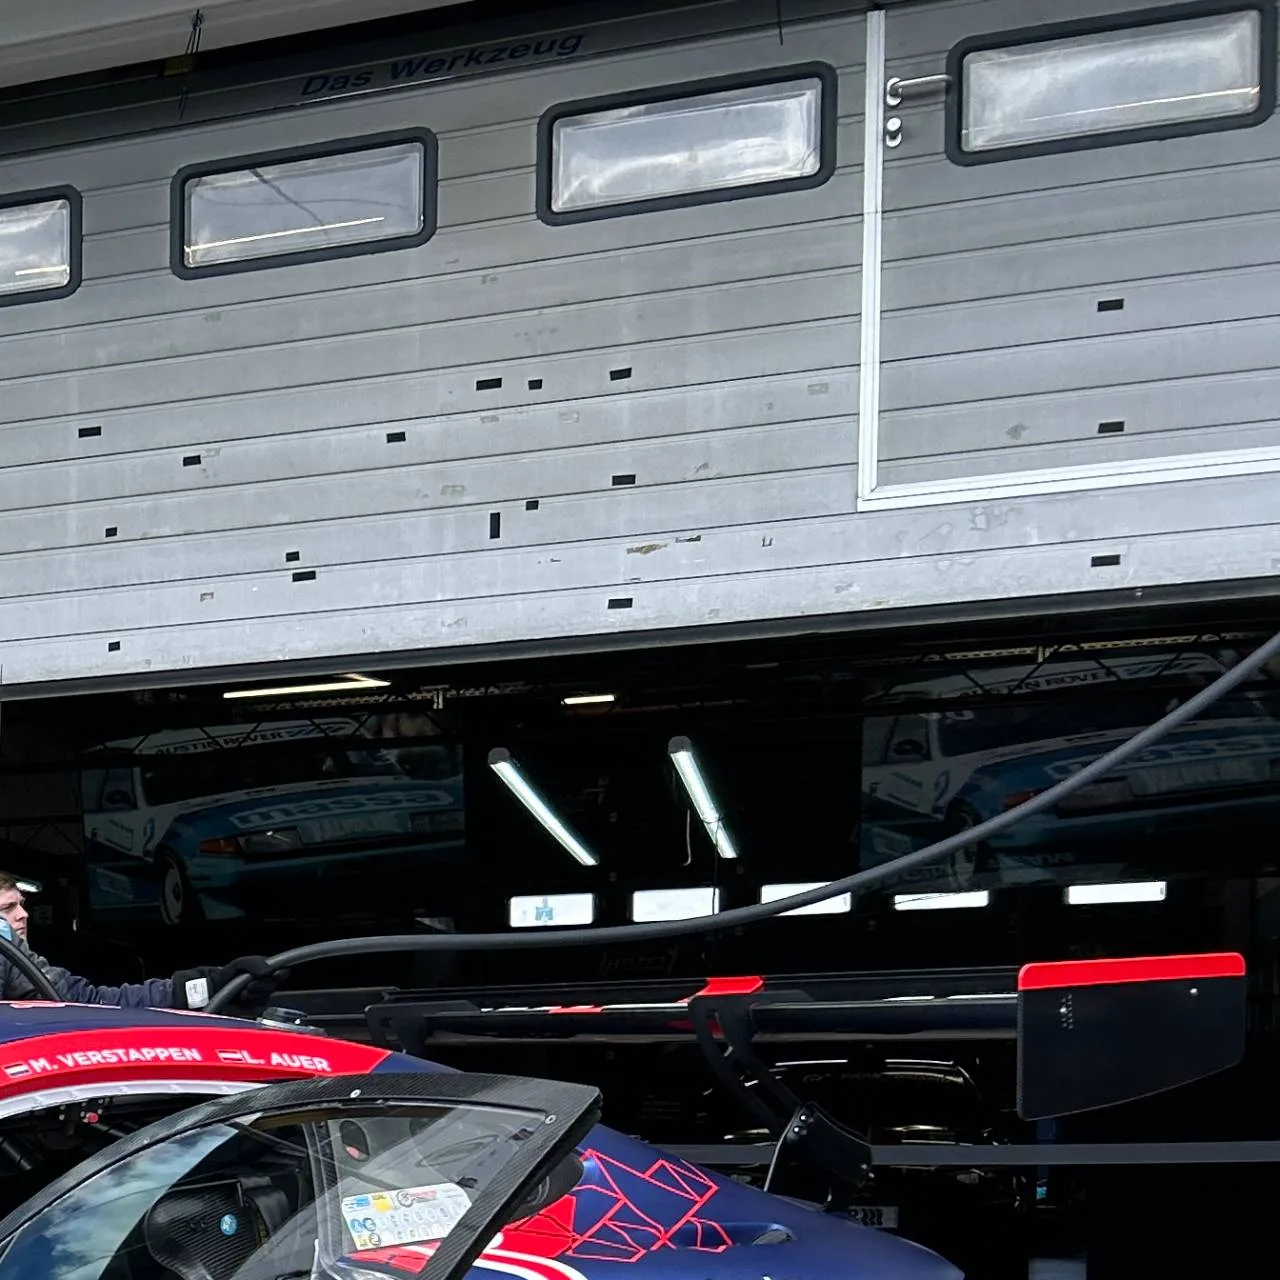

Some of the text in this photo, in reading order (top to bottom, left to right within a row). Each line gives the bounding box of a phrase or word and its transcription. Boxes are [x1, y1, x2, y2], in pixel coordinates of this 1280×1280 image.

[301, 33, 585, 96] Das Werkzeug
[28, 1048, 201, 1073] M. VERSTAPPEN
[244, 1050, 331, 1072] L. AUER
